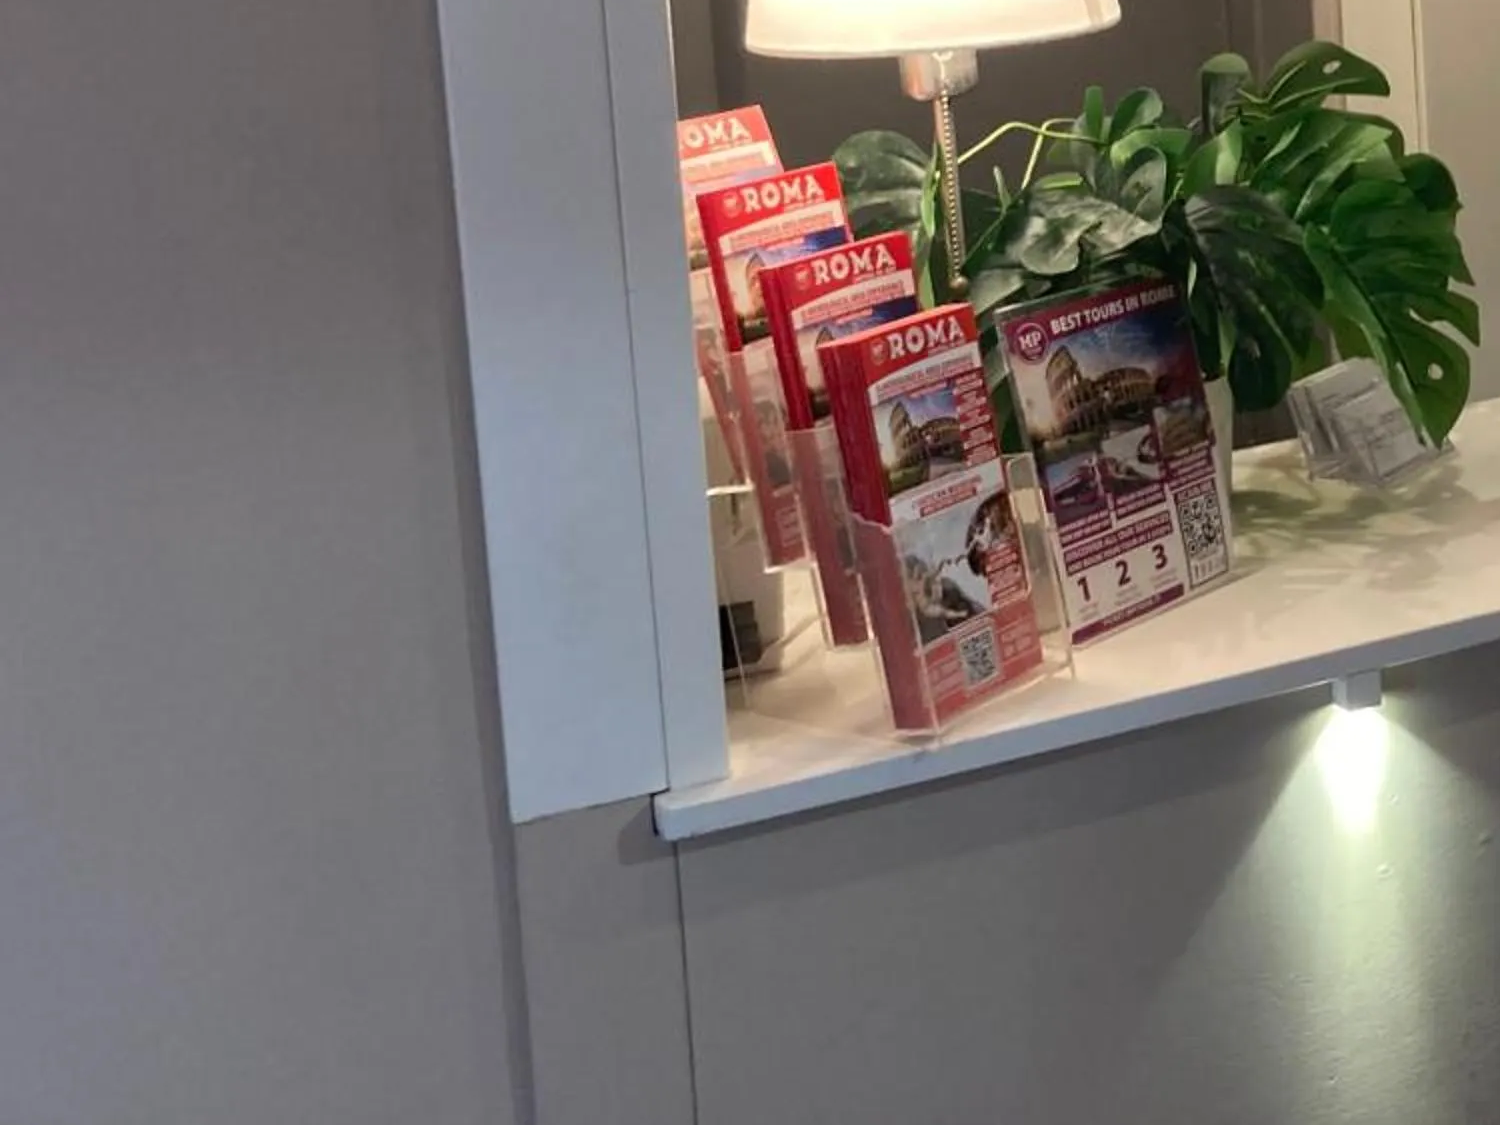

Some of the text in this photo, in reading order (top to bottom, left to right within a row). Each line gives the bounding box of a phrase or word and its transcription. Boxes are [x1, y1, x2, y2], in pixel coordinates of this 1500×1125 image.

[680, 117, 752, 149] OMA
[740, 173, 824, 213] ROMA
[810, 242, 896, 286] ROMA
[1050, 311, 1081, 335] BEST
[1084, 298, 1124, 323] TOURS
[1125, 293, 1139, 312] IN
[886, 314, 967, 360] ROMA
[1077, 576, 1091, 602] 1
[1115, 559, 1132, 586] 2
[1151, 543, 1168, 570] 3
